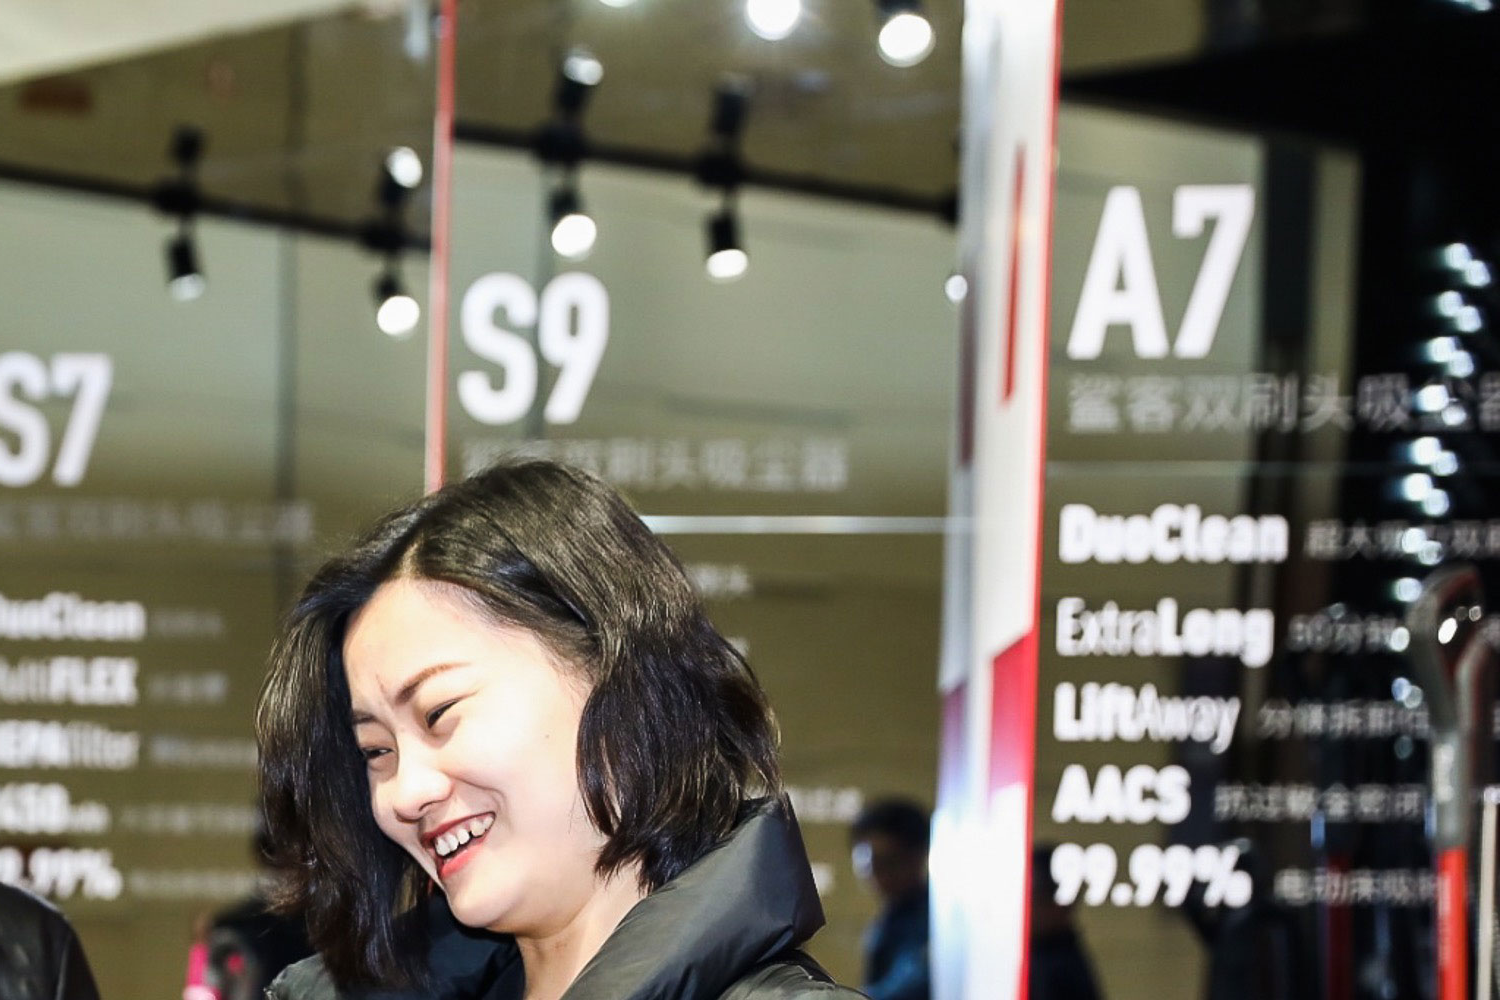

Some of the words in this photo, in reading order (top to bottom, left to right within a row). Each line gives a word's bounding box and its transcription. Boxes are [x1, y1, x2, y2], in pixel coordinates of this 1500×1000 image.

[1066, 184, 1256, 360] A7
[457, 272, 610, 425] S9
[1067, 373, 1500, 433] 鲨客双刷头吸
[1059, 504, 1289, 563] DuoClean
[1056, 597, 1274, 668] ExtraLong
[1054, 682, 1240, 755] LiftAway
[1052, 764, 1191, 824] AACS
[1051, 843, 1252, 908] 99.99%
